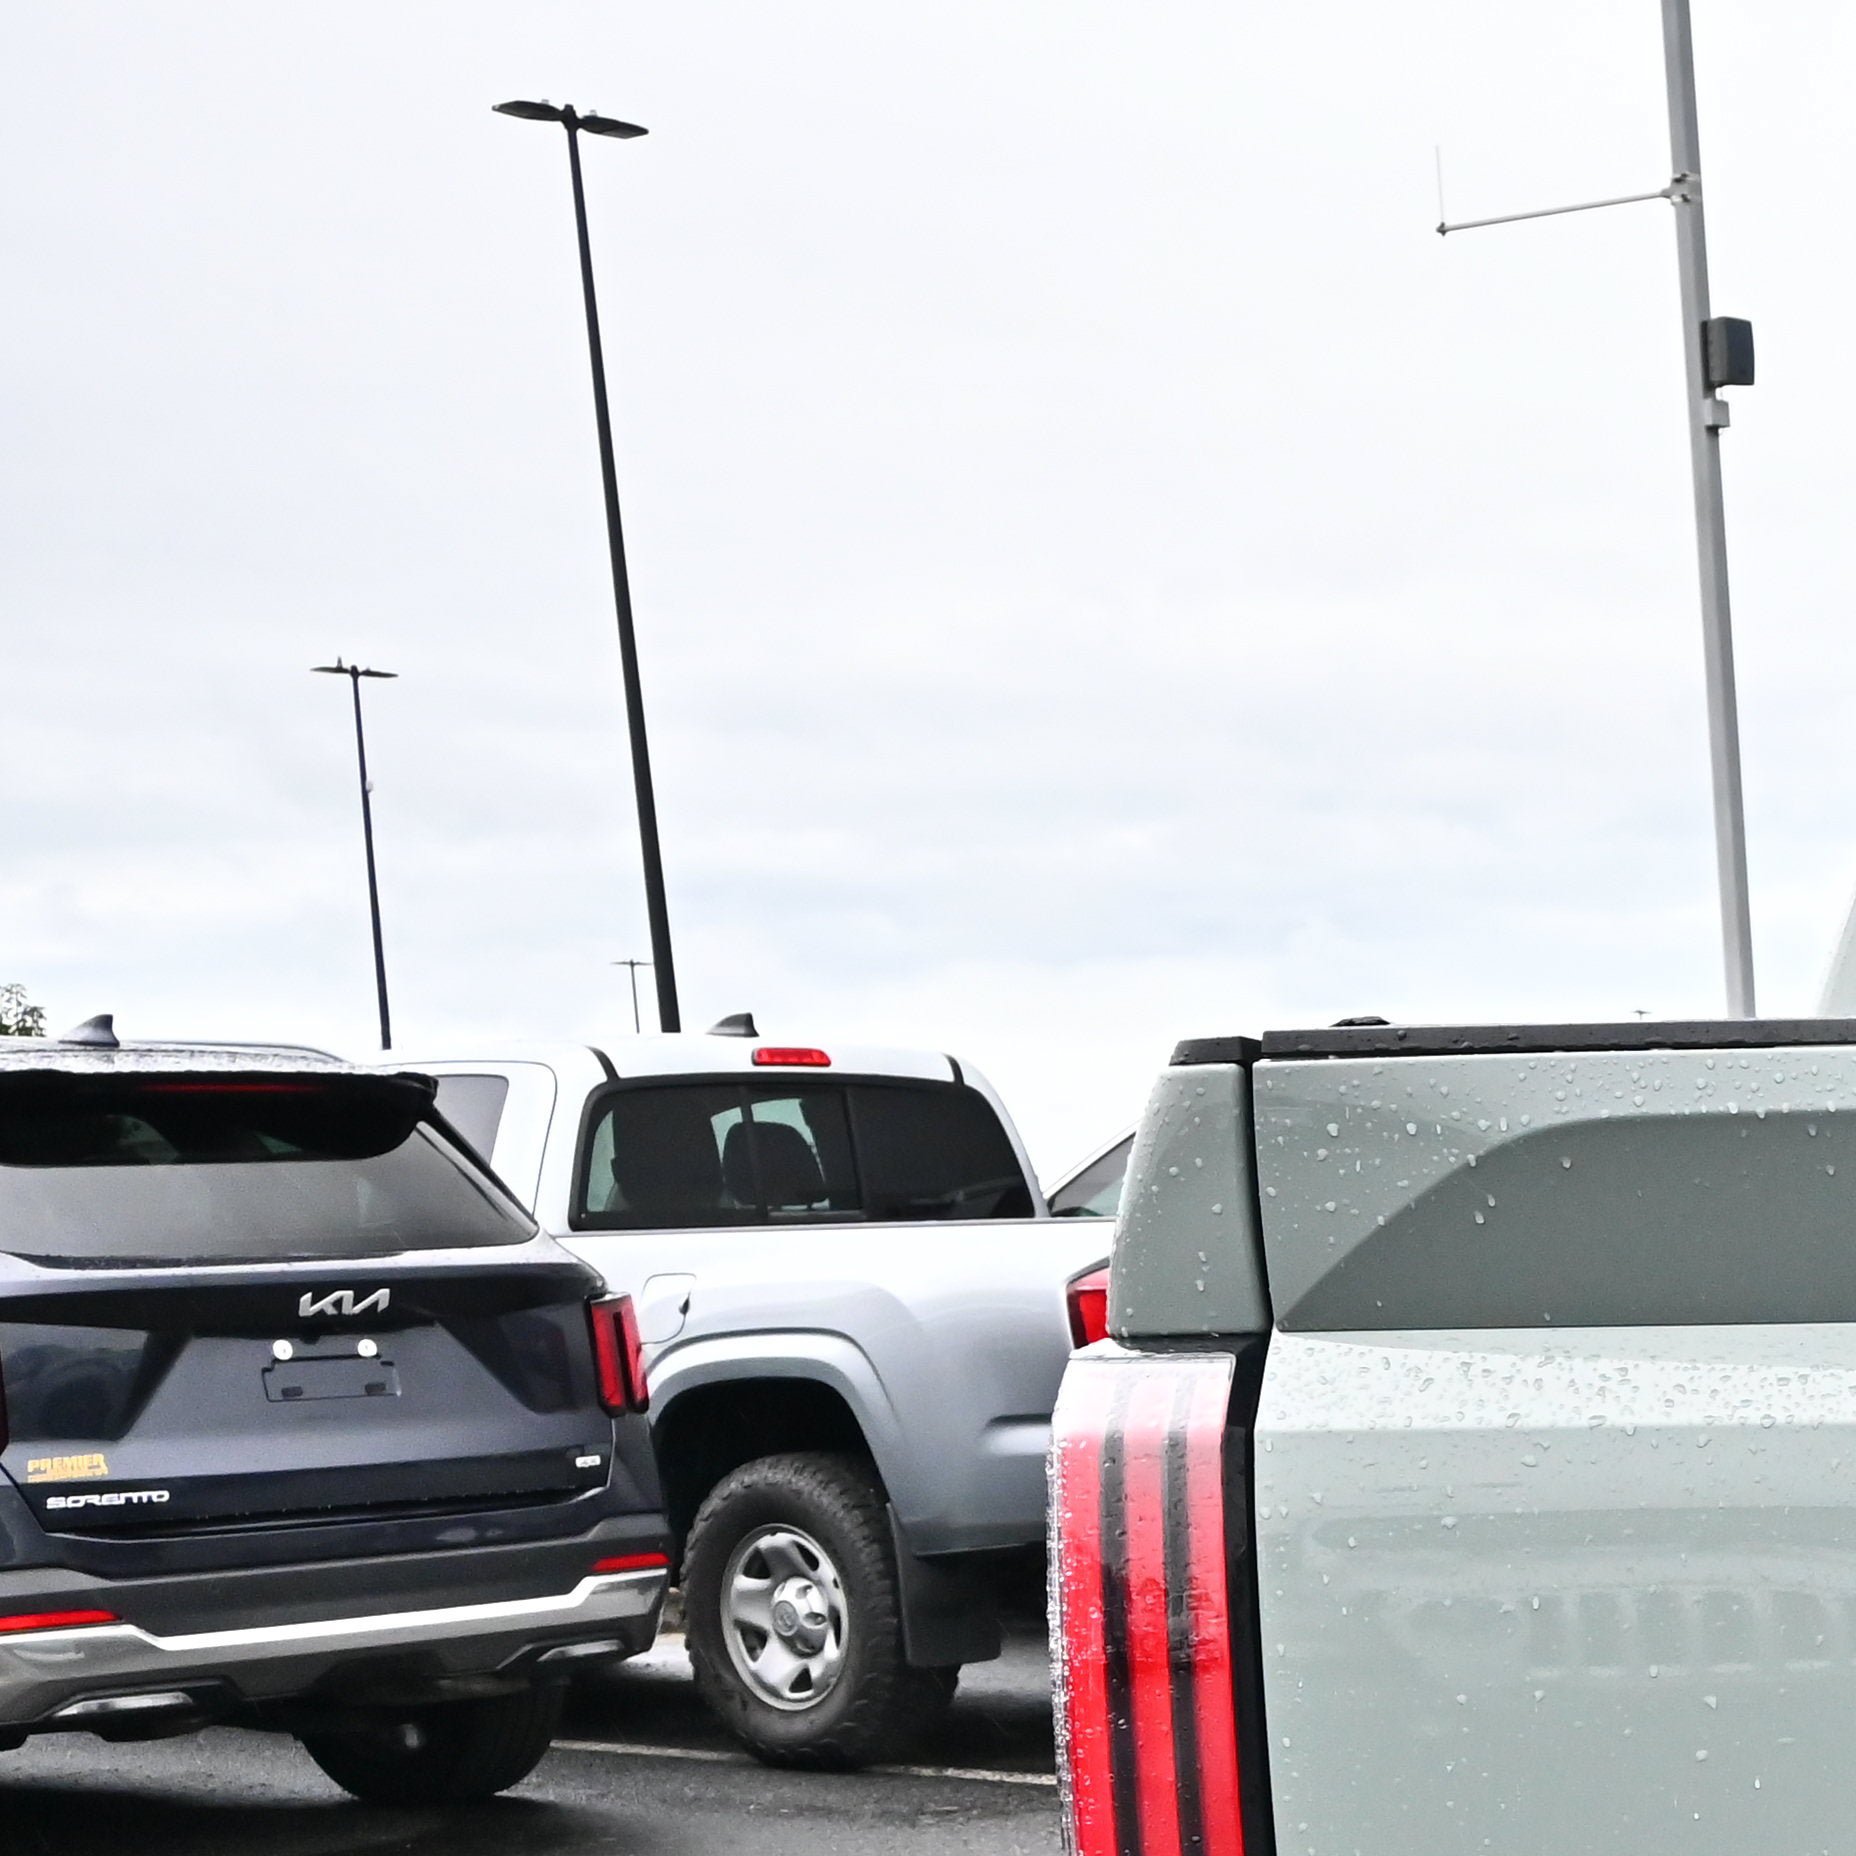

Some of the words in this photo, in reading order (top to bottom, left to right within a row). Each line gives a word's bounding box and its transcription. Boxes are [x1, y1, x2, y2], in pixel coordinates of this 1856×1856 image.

[299, 1288, 390, 1317] KIA
[26, 1453, 106, 1473] PREMIER
[46, 1490, 170, 1509] SORENTO
